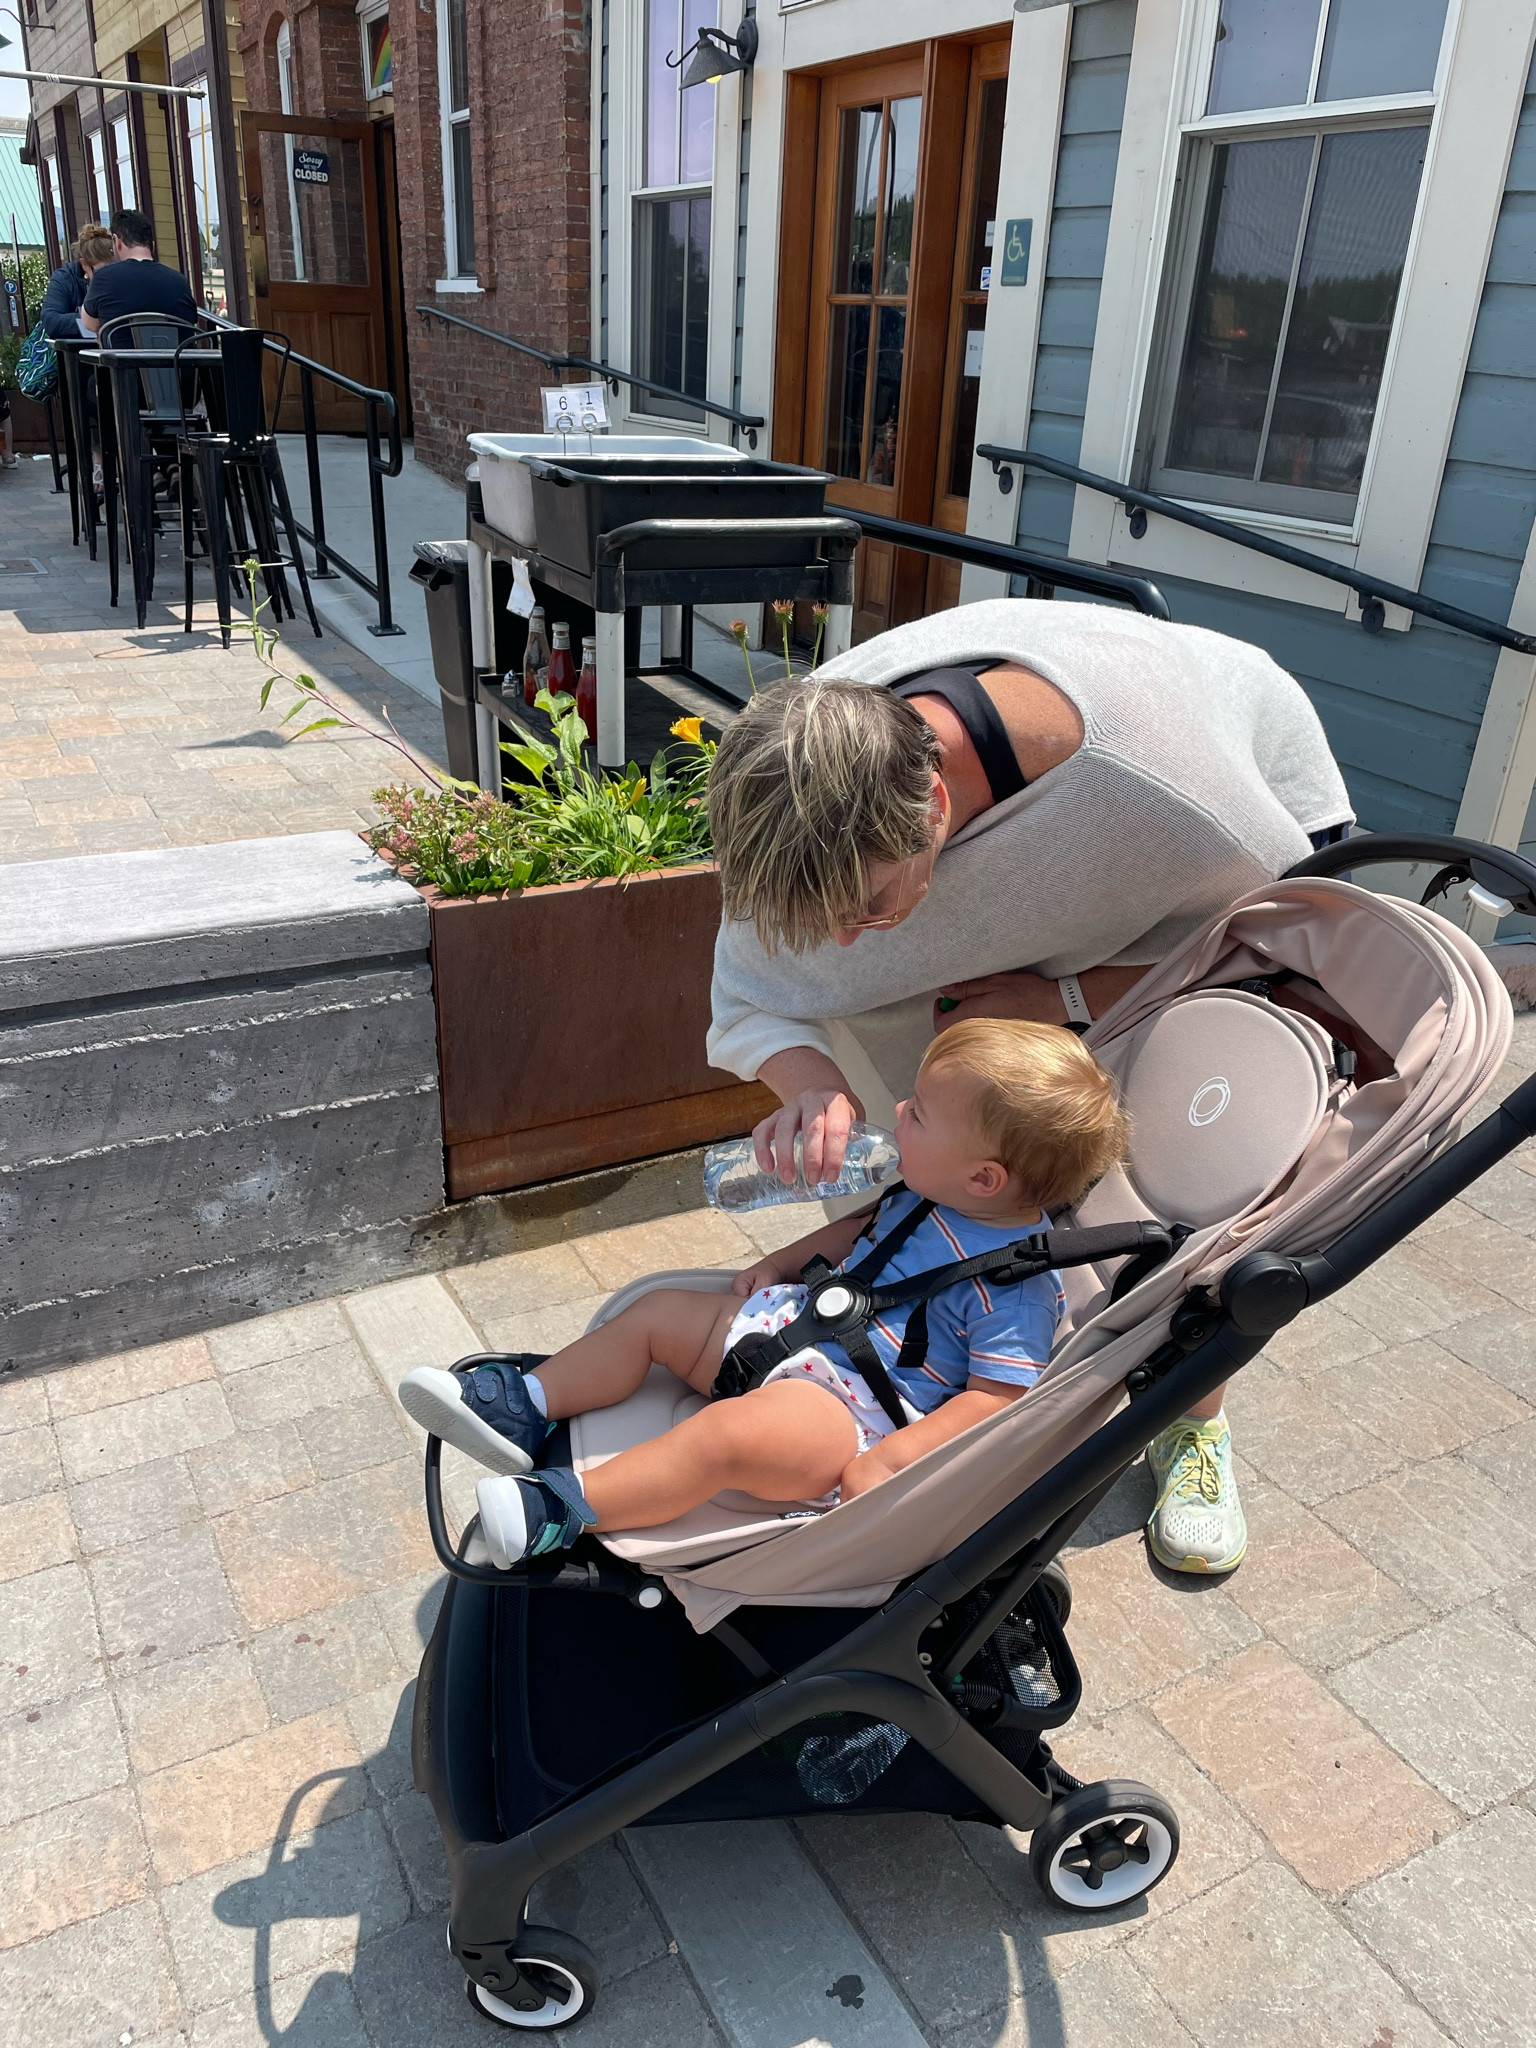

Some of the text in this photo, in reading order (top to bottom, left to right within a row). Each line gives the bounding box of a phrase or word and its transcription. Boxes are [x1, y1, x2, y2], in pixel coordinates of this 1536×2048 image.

[299, 153, 322, 168] Sorry
[295, 169, 328, 182] CLOSED
[559, 396, 568, 410] 6
